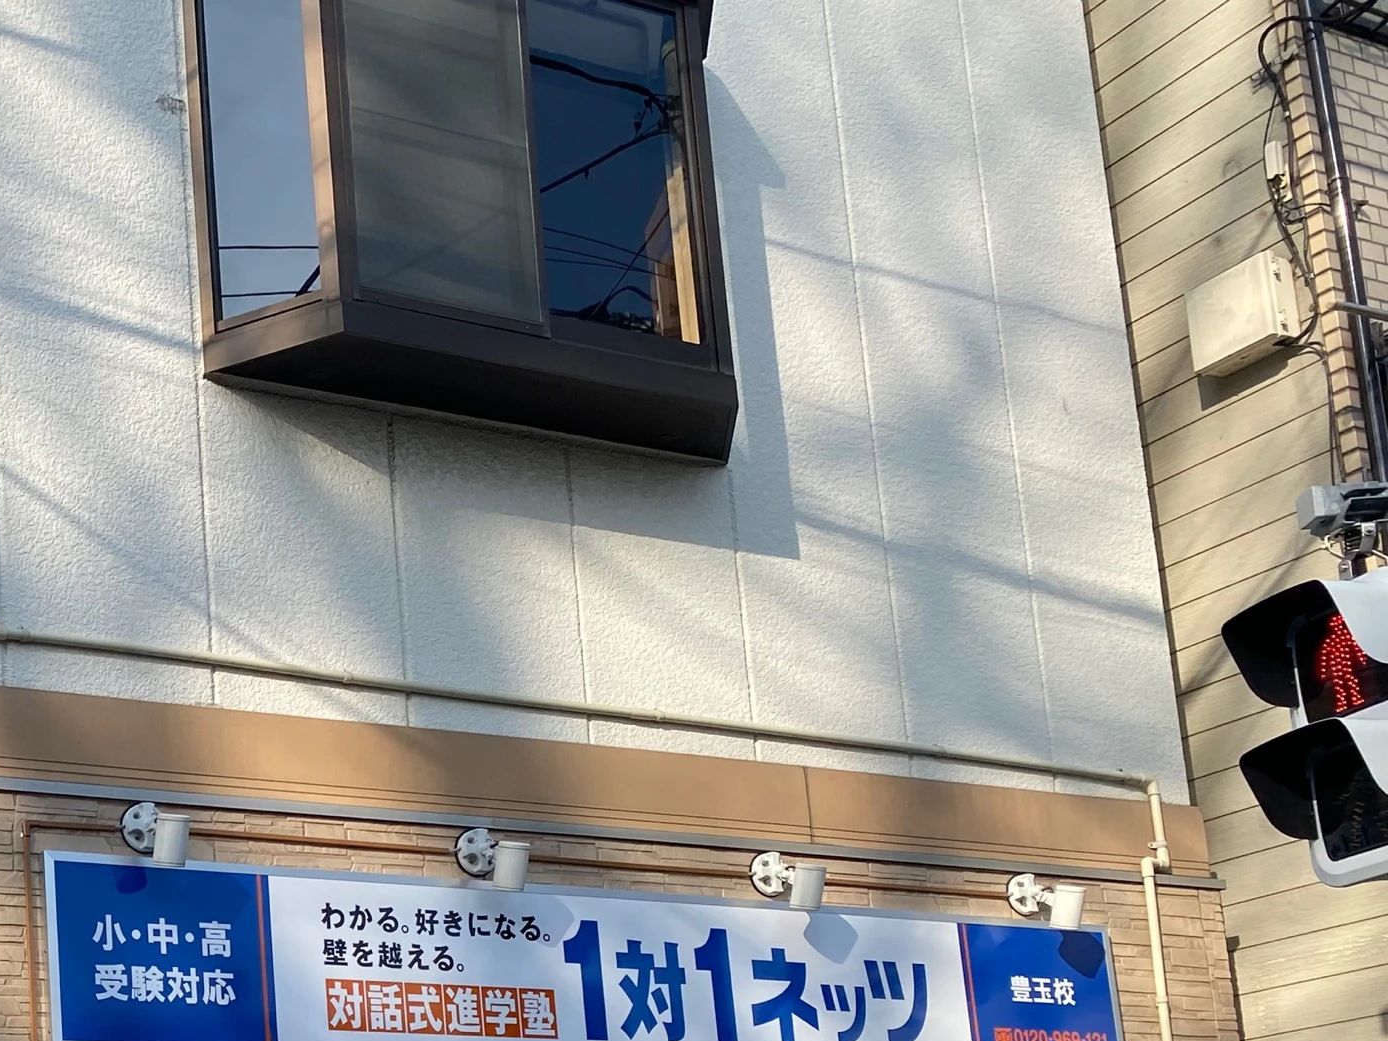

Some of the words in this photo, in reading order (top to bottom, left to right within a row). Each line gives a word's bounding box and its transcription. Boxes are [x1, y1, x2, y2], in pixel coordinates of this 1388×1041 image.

[91, 914, 233, 958] 小・中・高
[320, 902, 552, 943] わかる。好きになる。
[322, 940, 466, 972] 壁を越える。
[93, 965, 237, 1006] 受験対応
[1010, 976, 1076, 1007] 豊玉校
[326, 979, 558, 1039] 対話式進学塾
